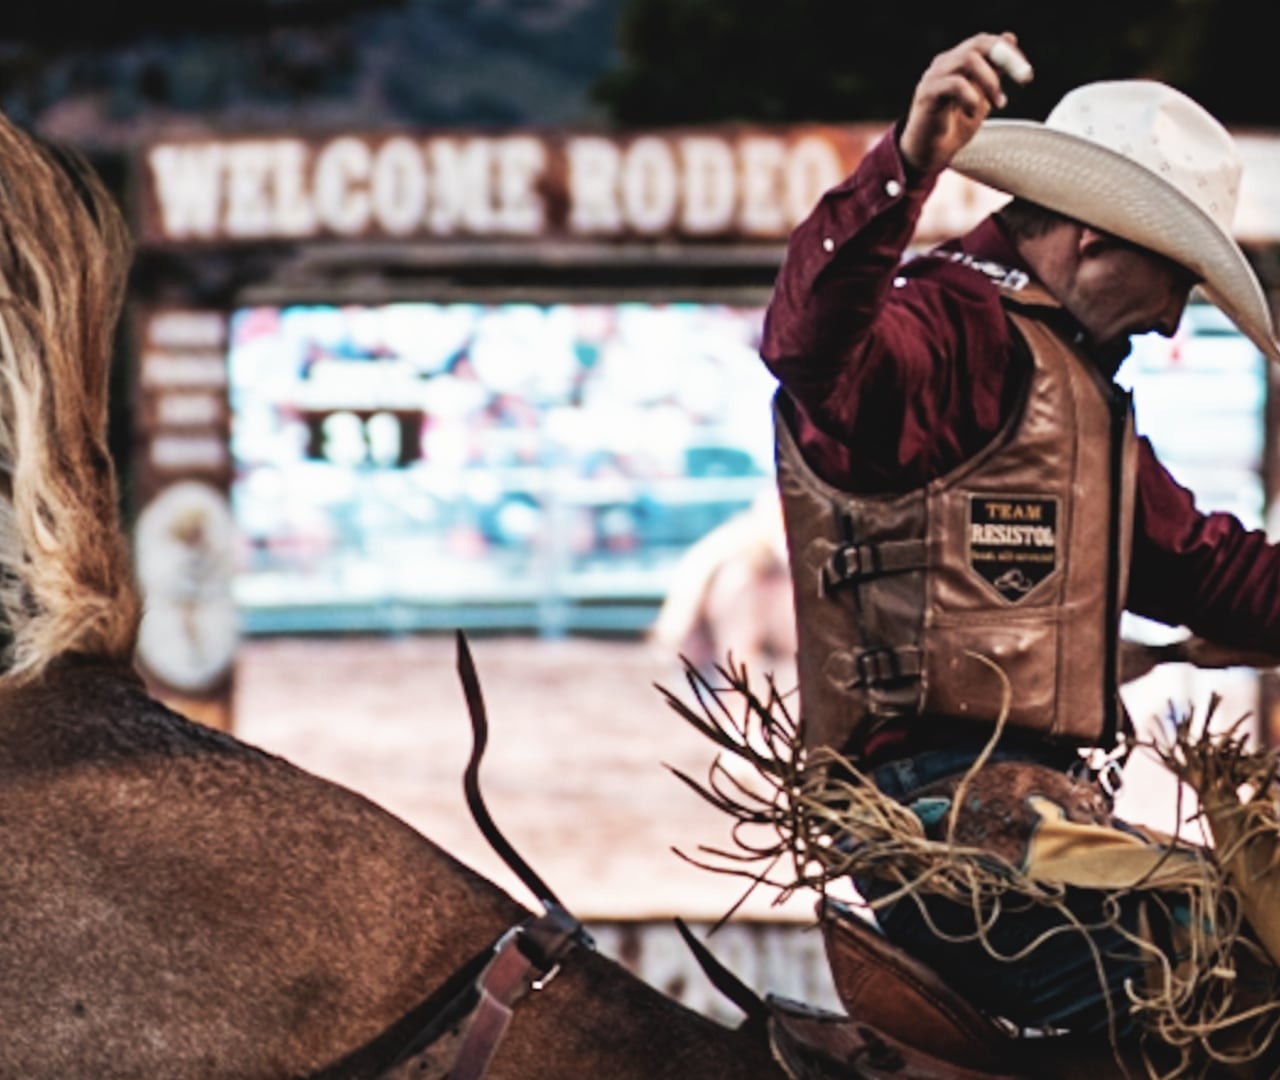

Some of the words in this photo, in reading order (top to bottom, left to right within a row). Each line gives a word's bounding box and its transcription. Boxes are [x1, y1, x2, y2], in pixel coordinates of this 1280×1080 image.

[148, 135, 548, 240] WELCOME
[567, 135, 844, 237] RODEO
[985, 503, 1042, 520] TEAM
[971, 523, 1055, 547] RESISTOL
